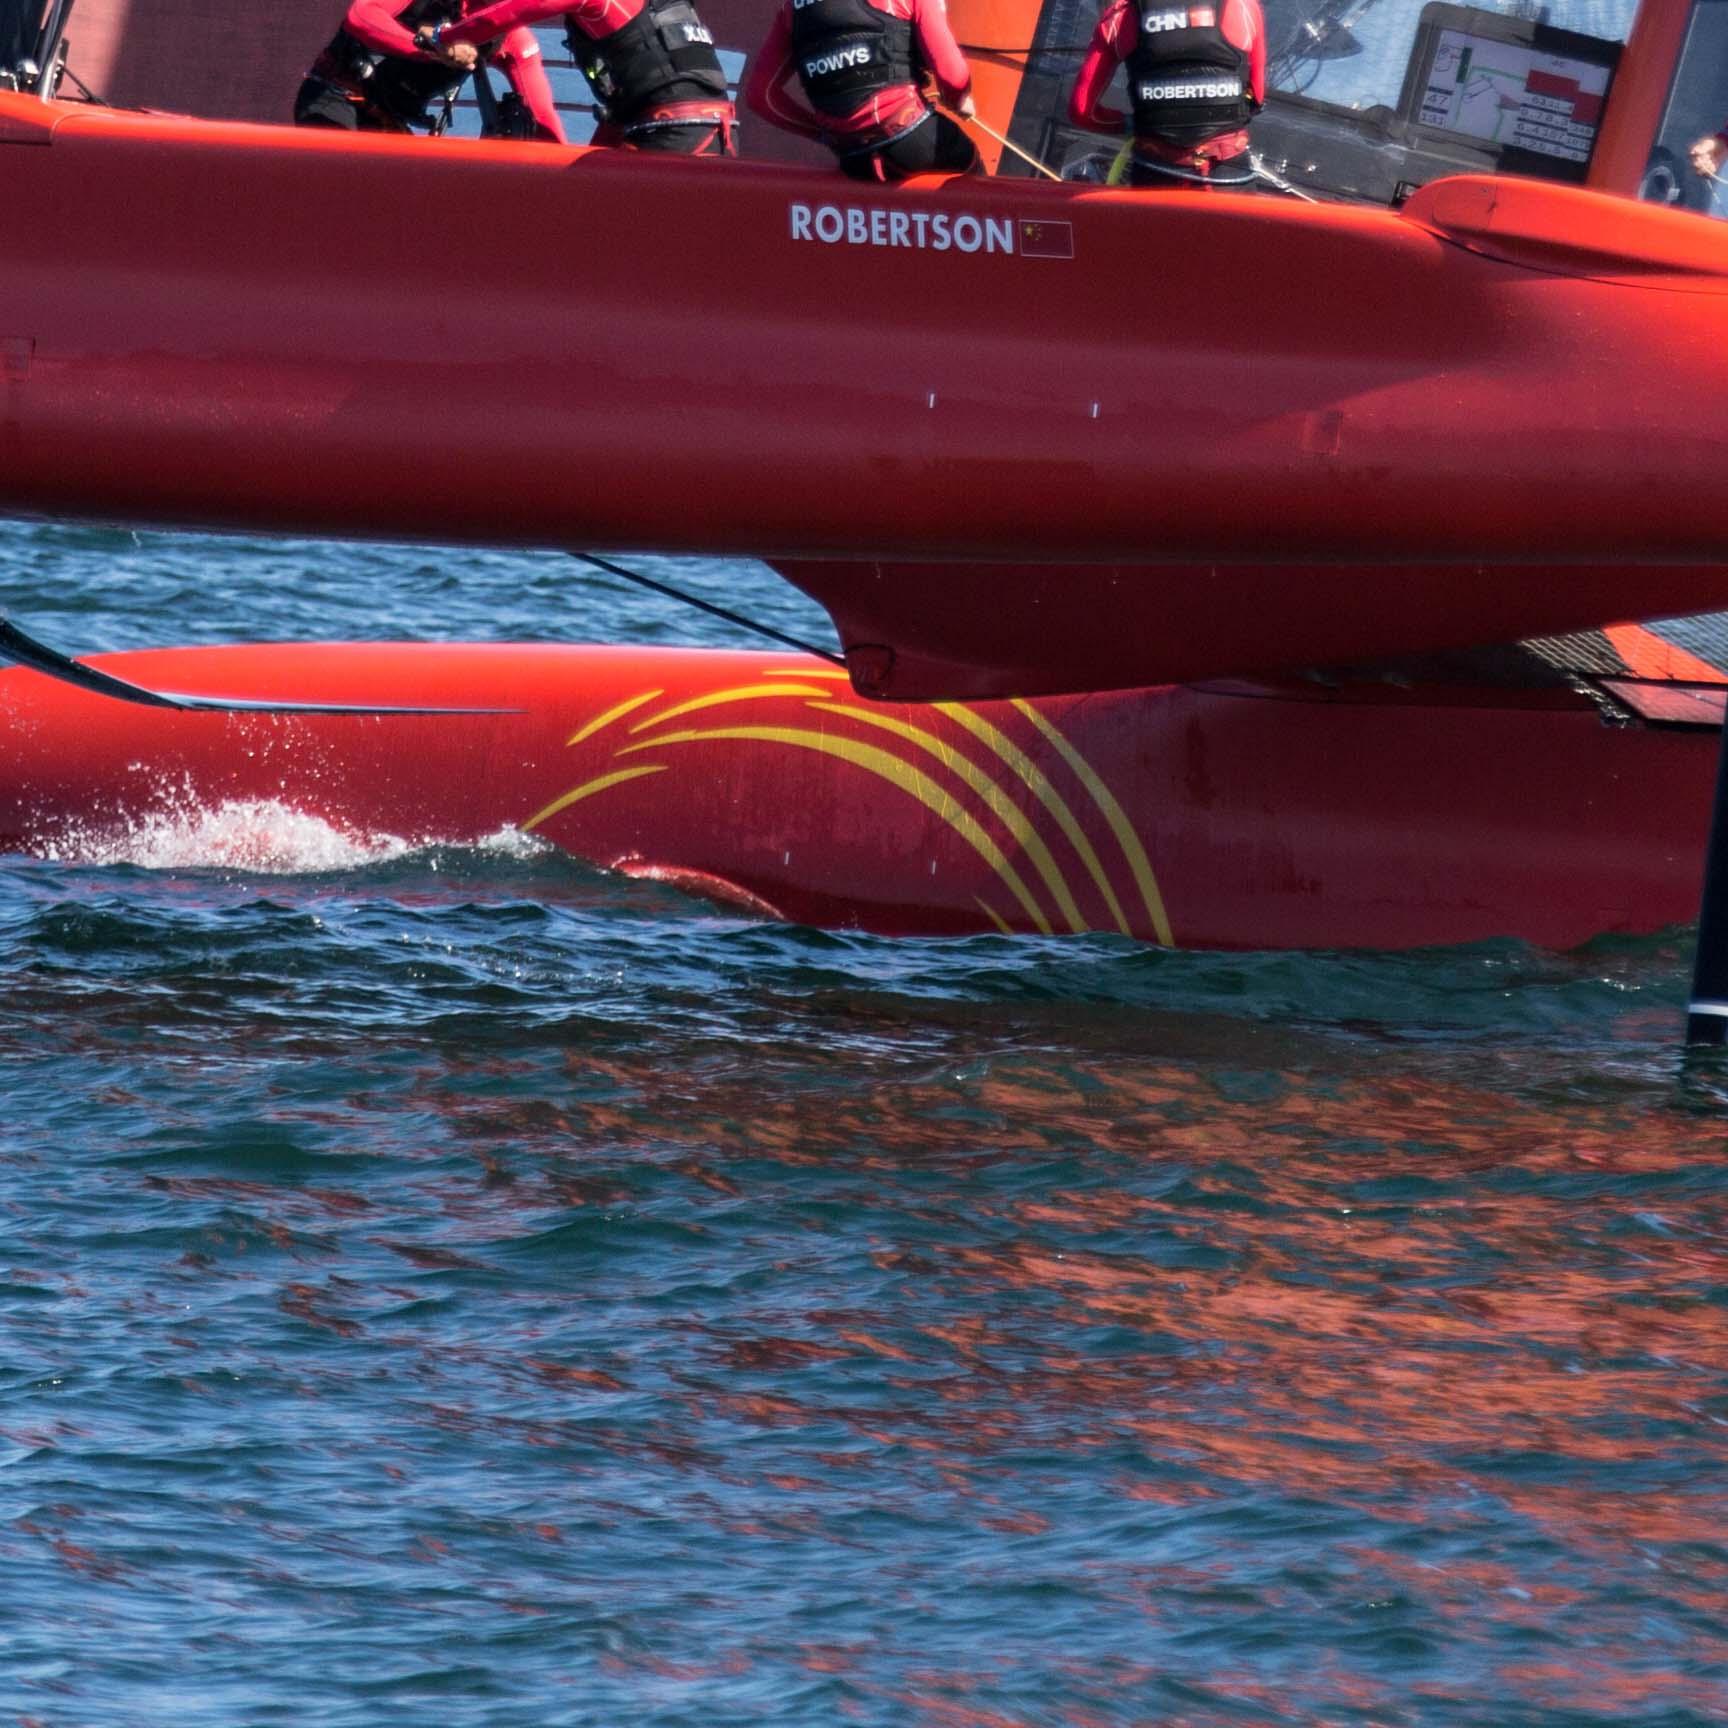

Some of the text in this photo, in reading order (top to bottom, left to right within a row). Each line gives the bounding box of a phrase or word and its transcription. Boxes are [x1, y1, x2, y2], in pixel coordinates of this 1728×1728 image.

[1145, 12, 1187, 33] CHN
[806, 47, 870, 77] POWYS
[1142, 83, 1240, 100] ROBERTSON
[791, 204, 1014, 254] ROBERTSON
